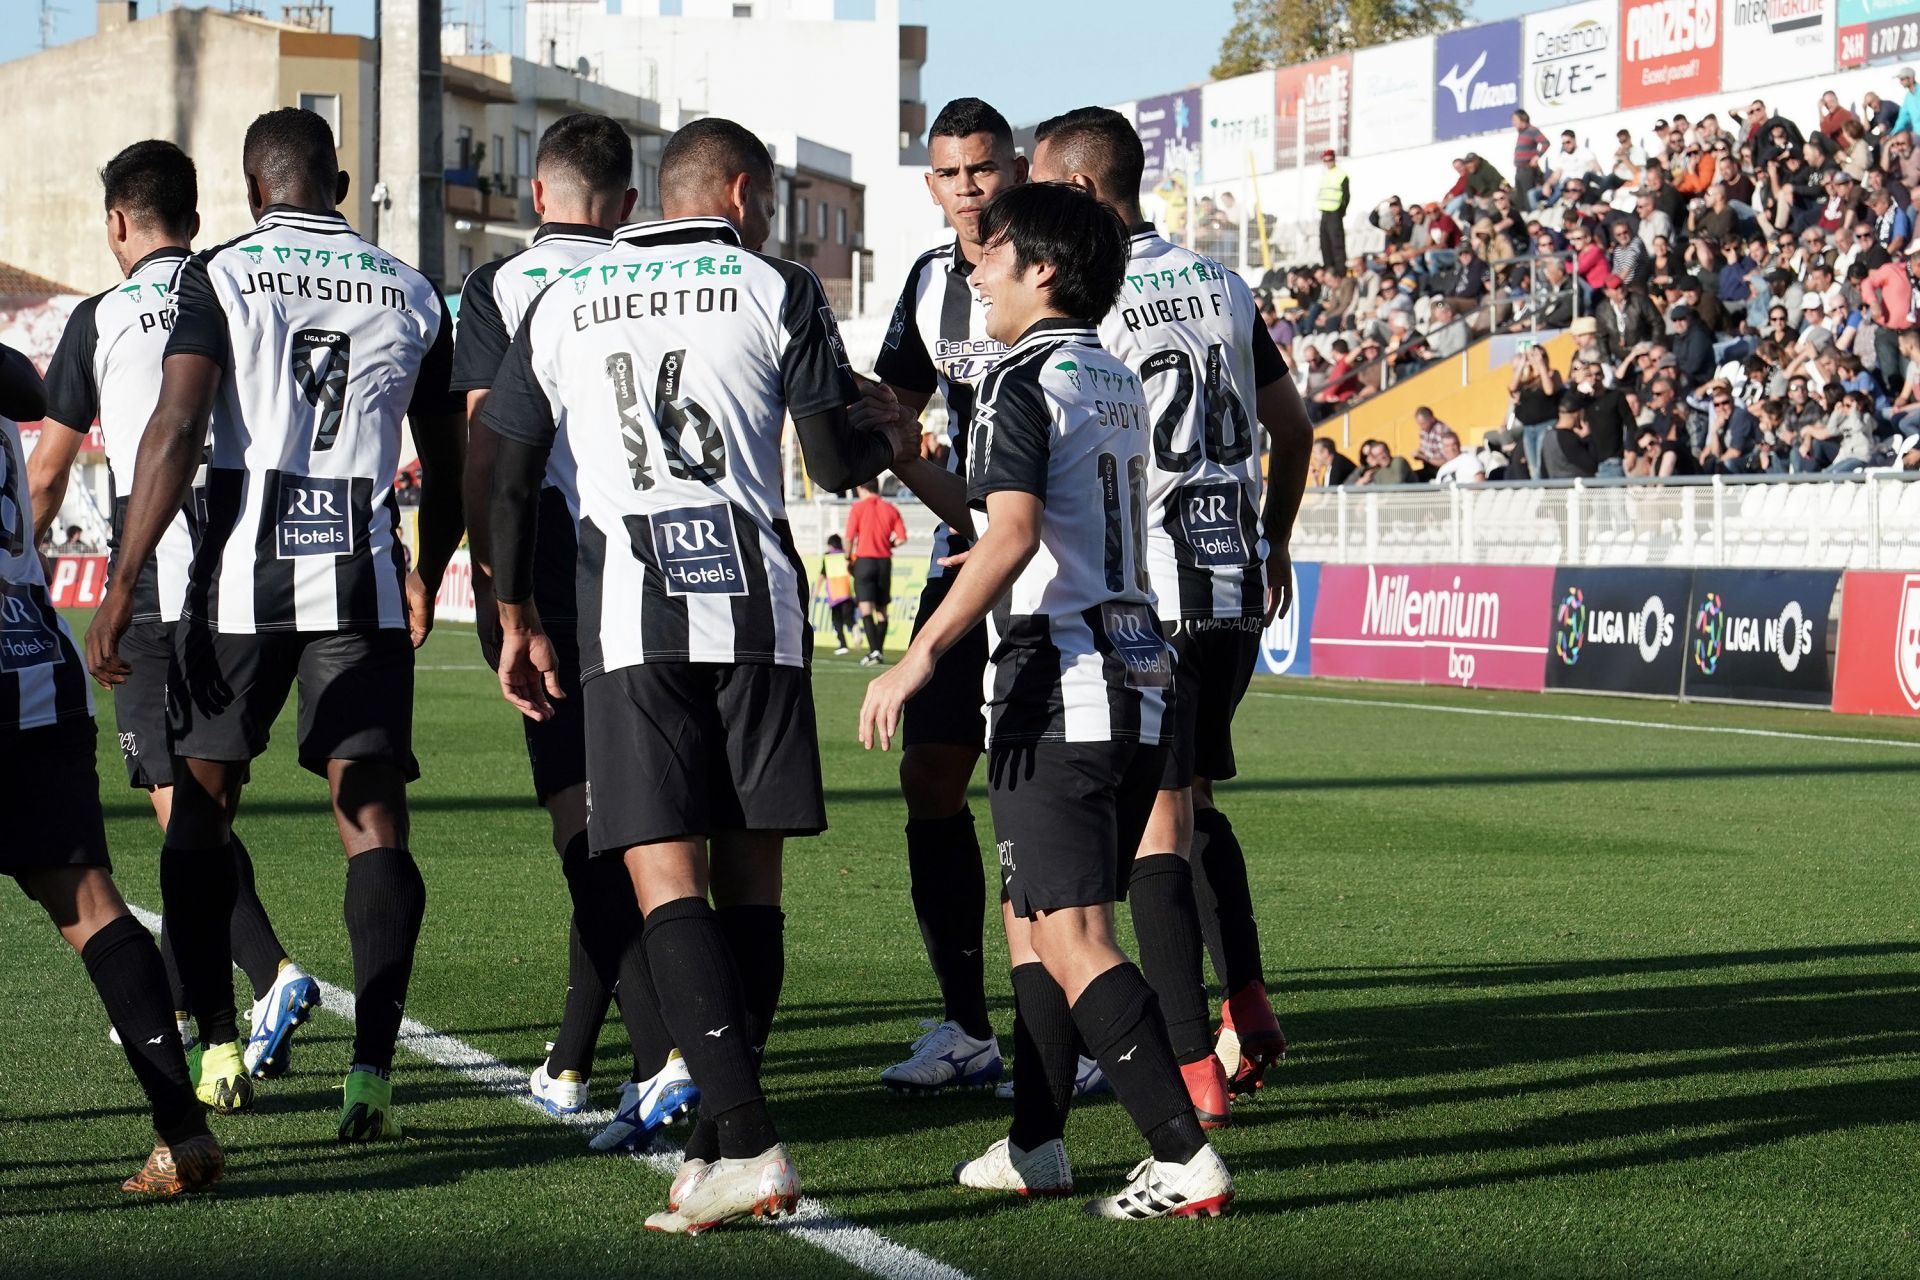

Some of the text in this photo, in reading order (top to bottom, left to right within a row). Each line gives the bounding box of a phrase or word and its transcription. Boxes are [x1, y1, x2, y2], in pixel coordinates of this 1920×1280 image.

[1535, 25, 1612, 58] Ceremony
[1841, 33, 1865, 61] 24H
[272, 245, 397, 277] ヤマダイ食品
[600, 254, 742, 286] ヤマダイ食品
[241, 272, 413, 313] JACKSON M.
[573, 287, 738, 332] EWERTON
[1122, 295, 1205, 333] RUBEN
[304, 334, 320, 343] LIGA
[1150, 359, 1164, 368] LIGA
[292, 328, 352, 452] 9
[665, 378, 674, 396] LIGA
[604, 349, 728, 491] 16
[1140, 343, 1253, 473] 26
[285, 487, 343, 516] RR
[1185, 495, 1233, 525] RR
[284, 527, 344, 545] Hotels
[659, 519, 729, 554] RR
[1192, 535, 1240, 555] Hotels
[668, 562, 736, 584] Hotels
[1361, 565, 1499, 639] Millennium
[1108, 613, 1155, 641] RR
[1587, 595, 1675, 663] LIGA NOS
[1725, 600, 1813, 672] LIGA NOS
[1125, 653, 1169, 673] Hotels
[1448, 646, 1475, 687] bcp
